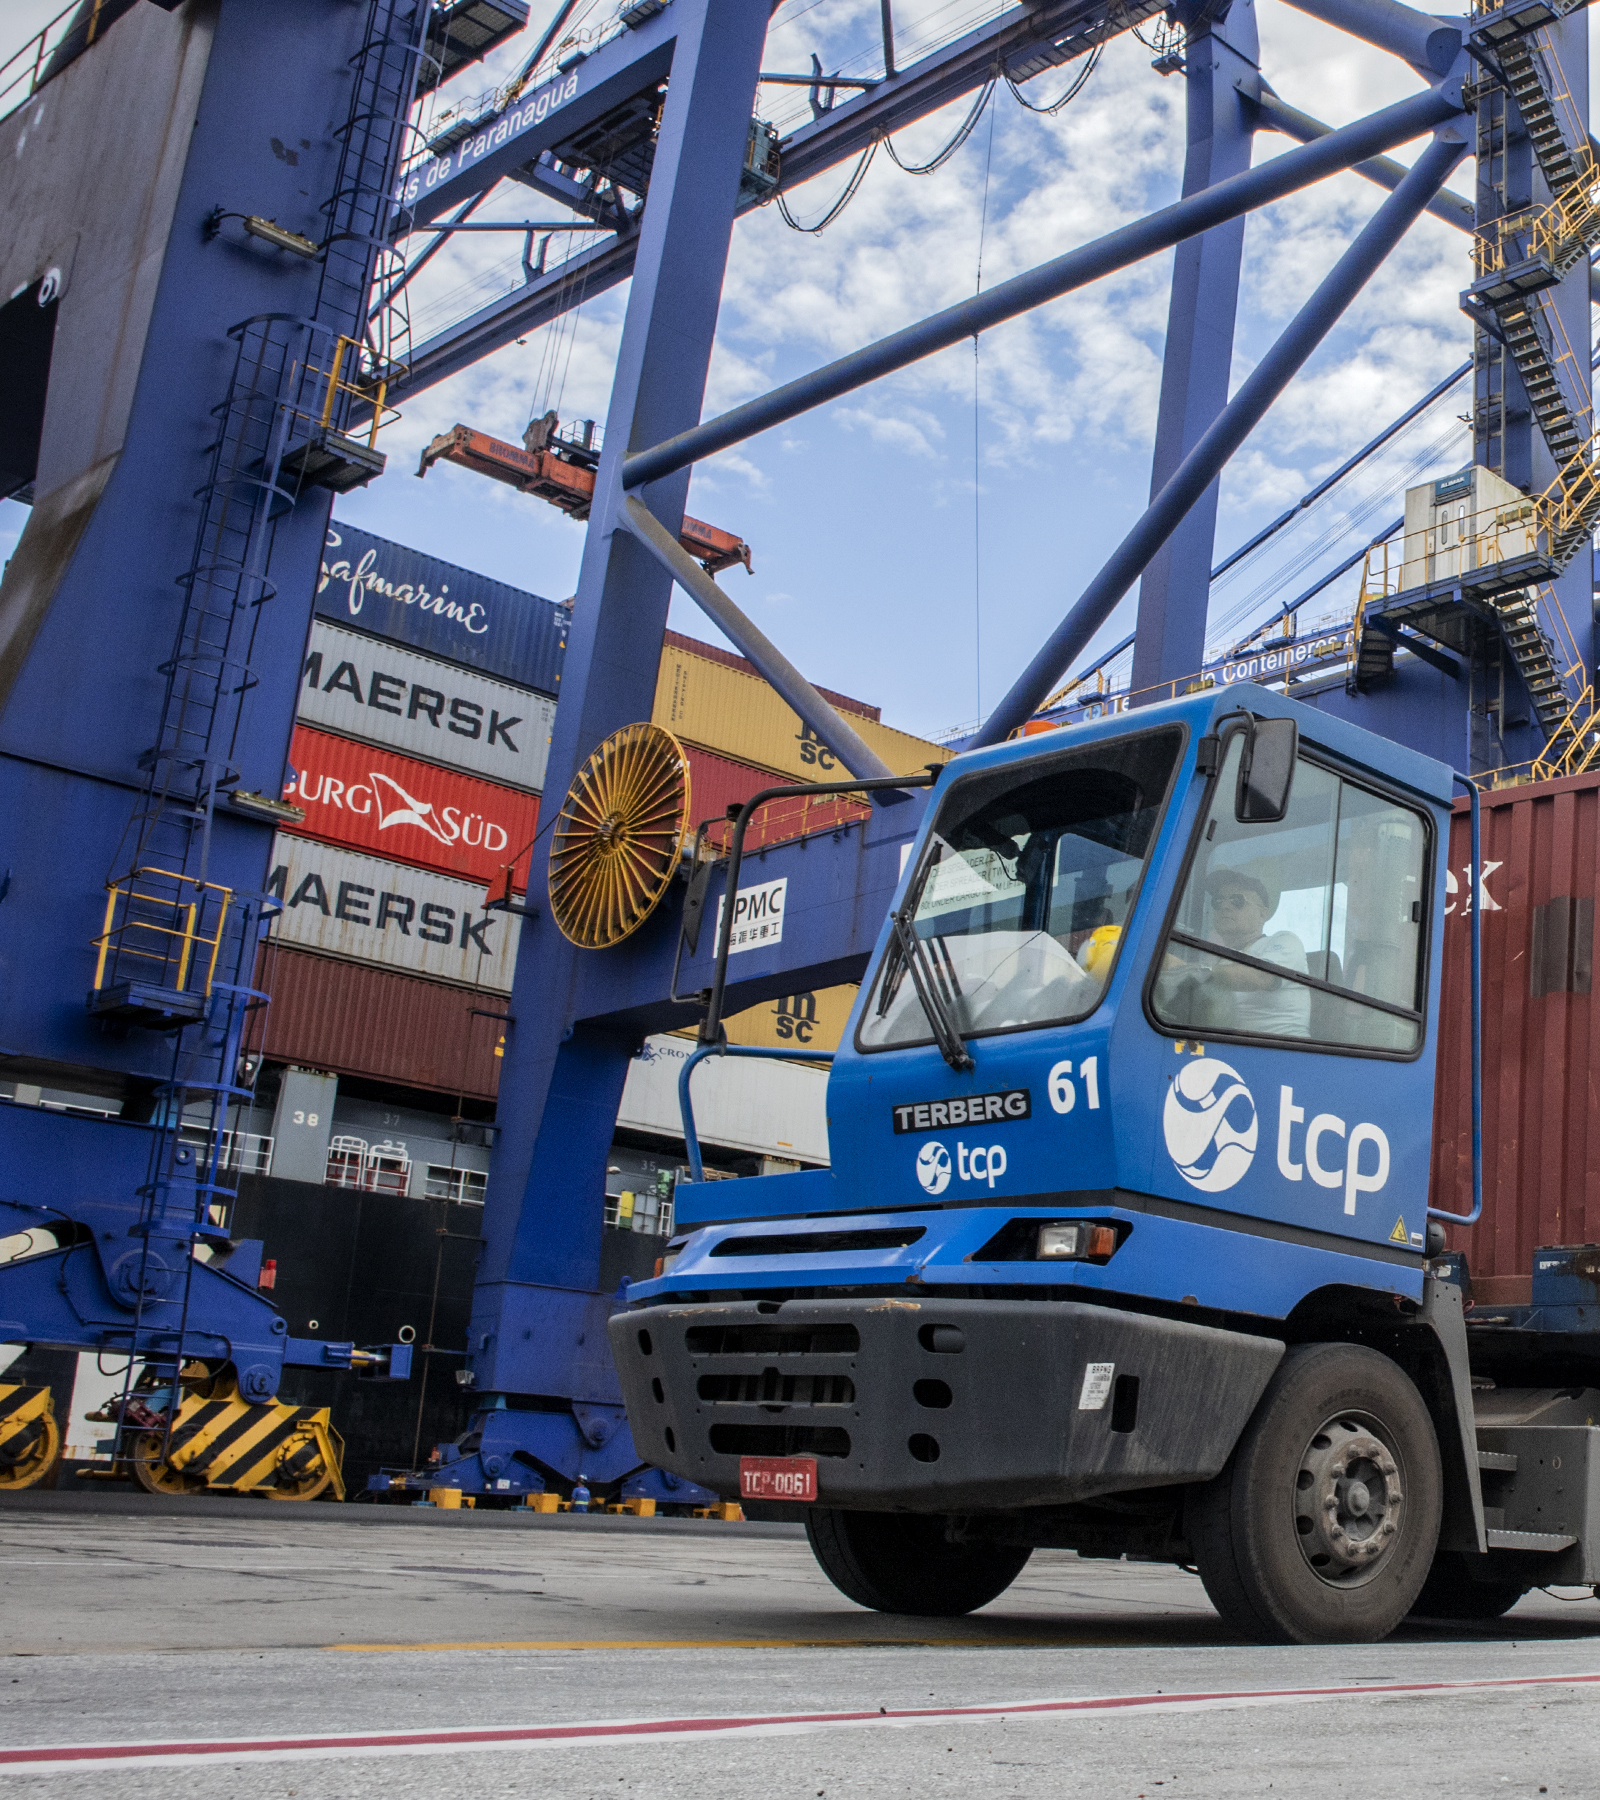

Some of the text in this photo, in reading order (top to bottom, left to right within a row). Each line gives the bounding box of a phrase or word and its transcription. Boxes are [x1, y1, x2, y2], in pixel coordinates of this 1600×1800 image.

[425, 158, 451, 187] de
[458, 68, 578, 167] Paranaguá
[303, 651, 523, 753] MAERSK
[442, 806, 508, 851] SÜD
[659, 1047, 711, 1065] CRONS
[1048, 1056, 1100, 1114] 61
[293, 1110, 319, 1127] 38
[383, 1112, 400, 1127] 37
[895, 1092, 1027, 1130] TERBERG
[957, 1141, 1007, 1188] tcp
[1277, 1084, 1390, 1215] tcp
[744, 1471, 810, 1495] TCP-0061
